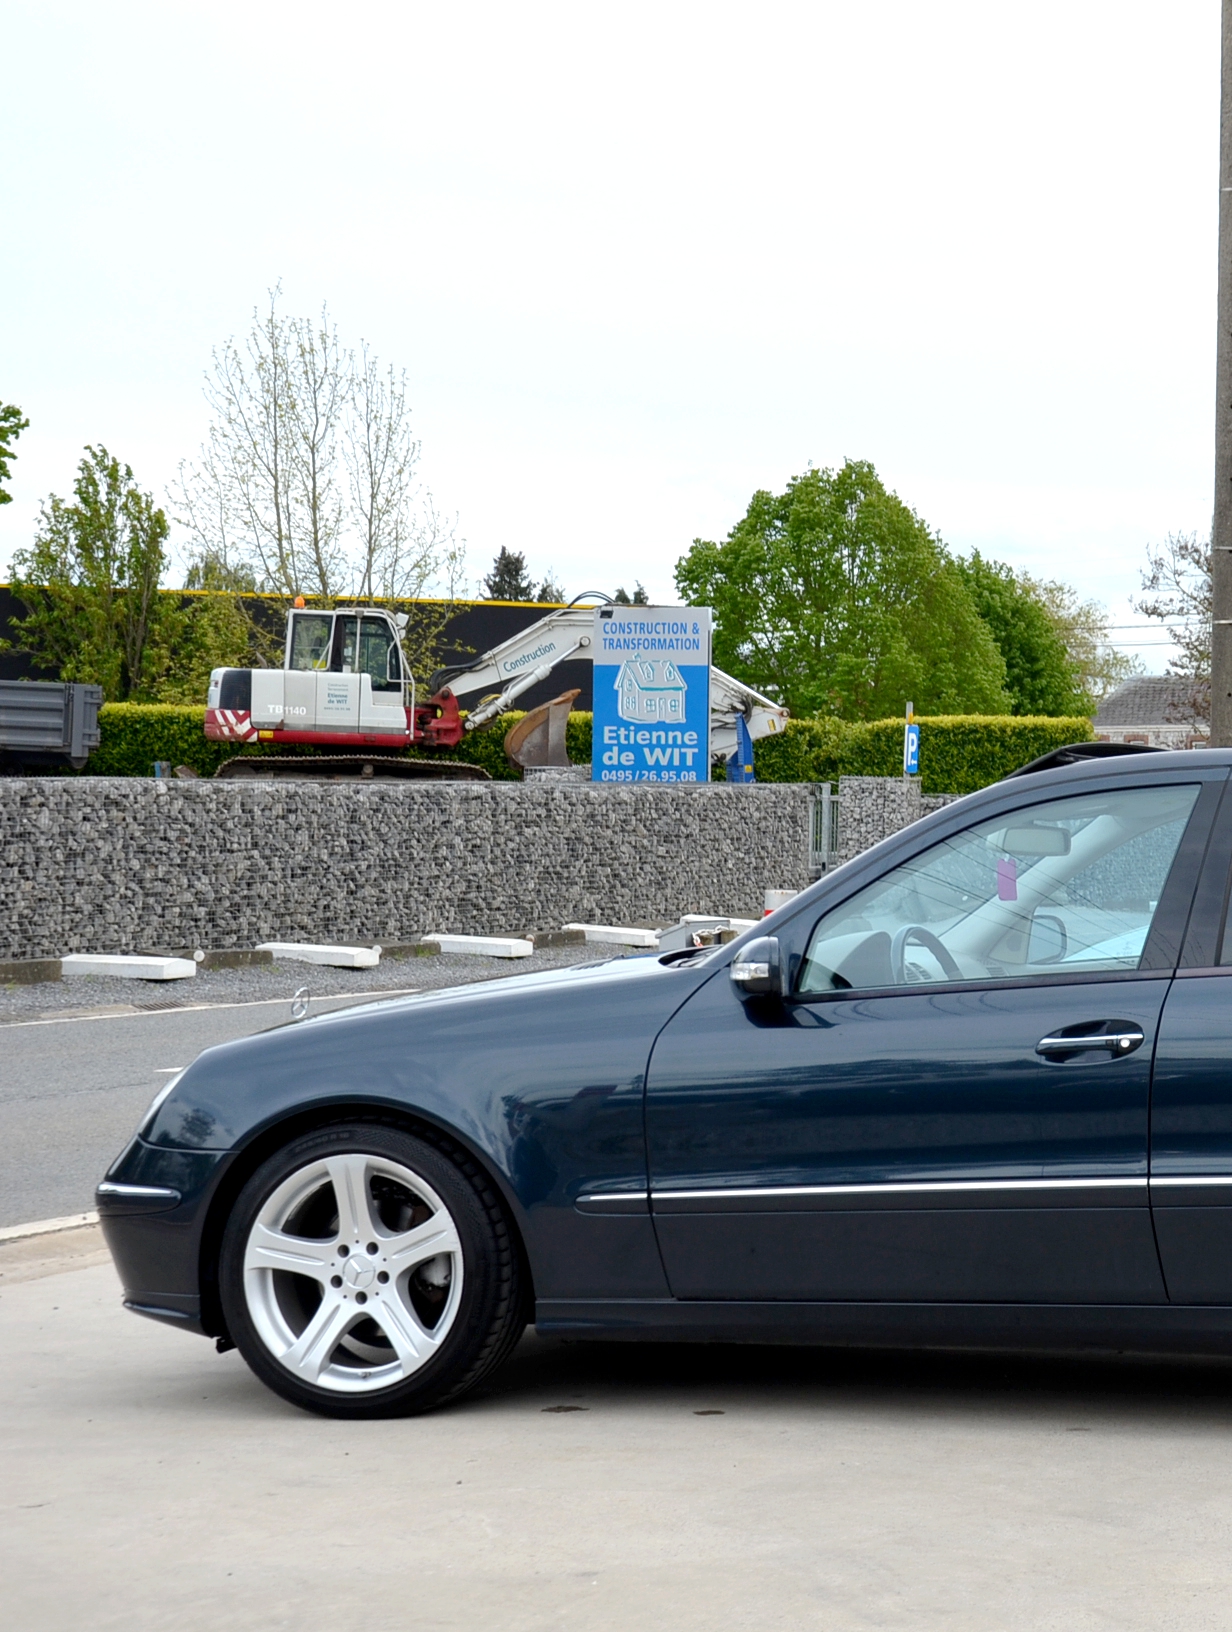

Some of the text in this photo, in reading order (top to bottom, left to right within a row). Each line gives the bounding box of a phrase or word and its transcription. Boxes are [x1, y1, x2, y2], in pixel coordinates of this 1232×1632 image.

[603, 622, 700, 635] CONSTRUCTION &
[602, 637, 700, 650] TRANSFORMATION
[503, 642, 556, 673] Construction
[603, 726, 698, 745] Etienne
[602, 746, 699, 767] de WIT
[907, 732, 918, 766] P
